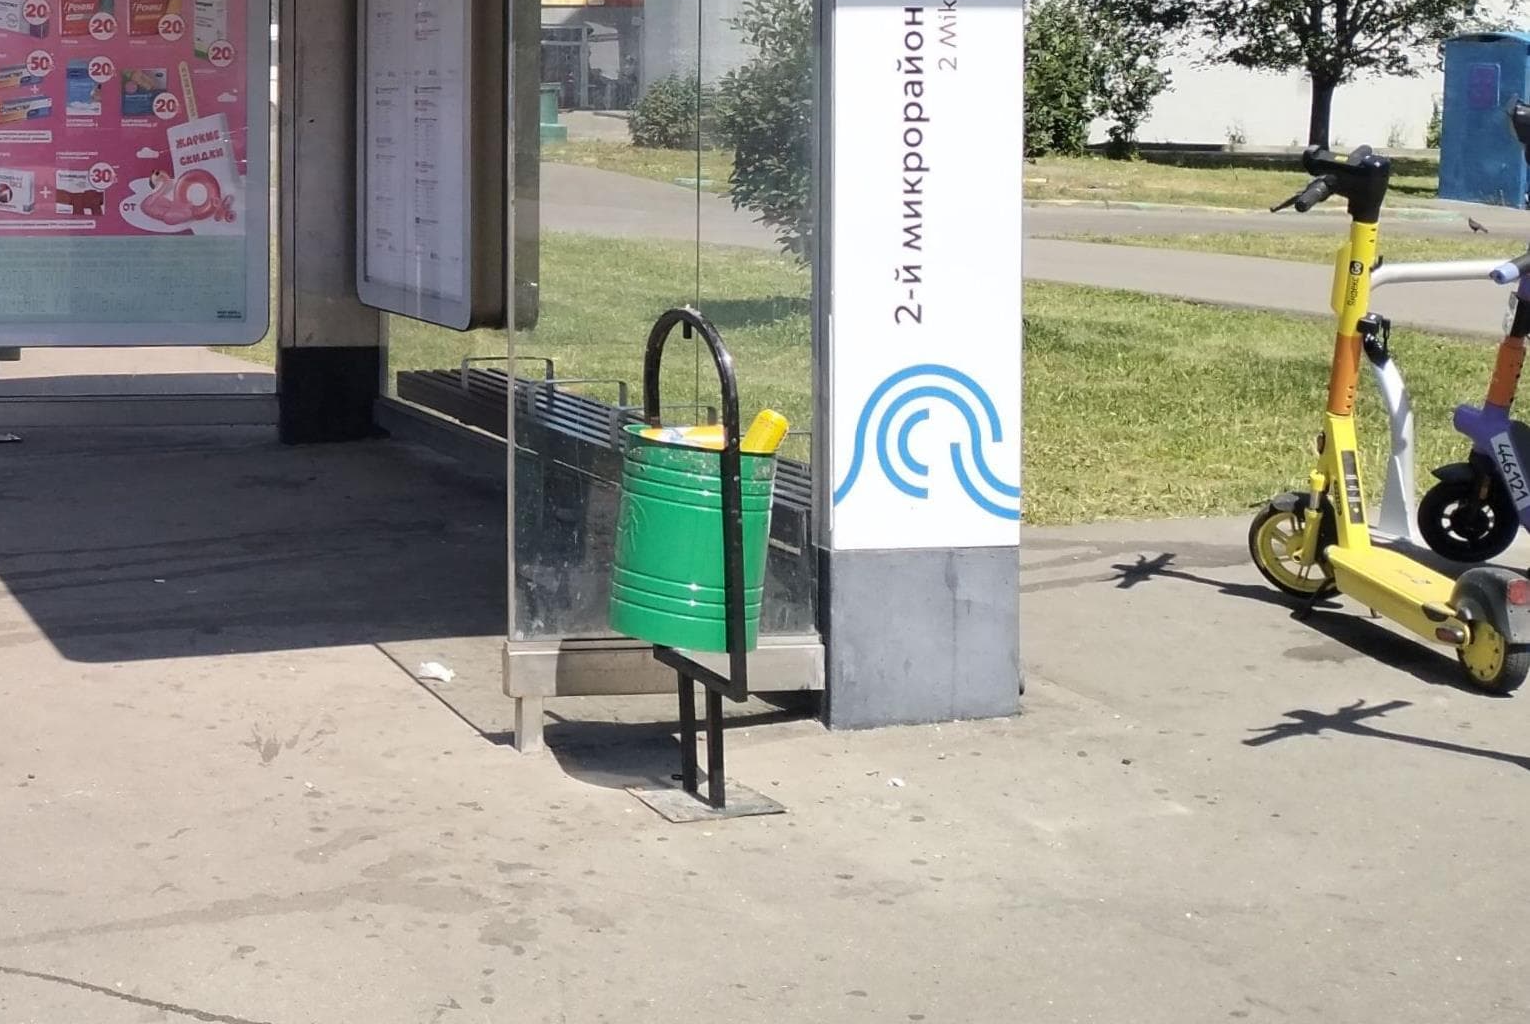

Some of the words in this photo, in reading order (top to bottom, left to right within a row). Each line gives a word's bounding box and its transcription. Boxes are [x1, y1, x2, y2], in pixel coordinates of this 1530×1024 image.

[937, 56, 958, 72] 2
[175, 129, 220, 149] ЖАРКИЕ
[897, 6, 930, 251] микрорайон
[894, 264, 922, 325] 2-й
[1497, 443, 1529, 504] 446121
